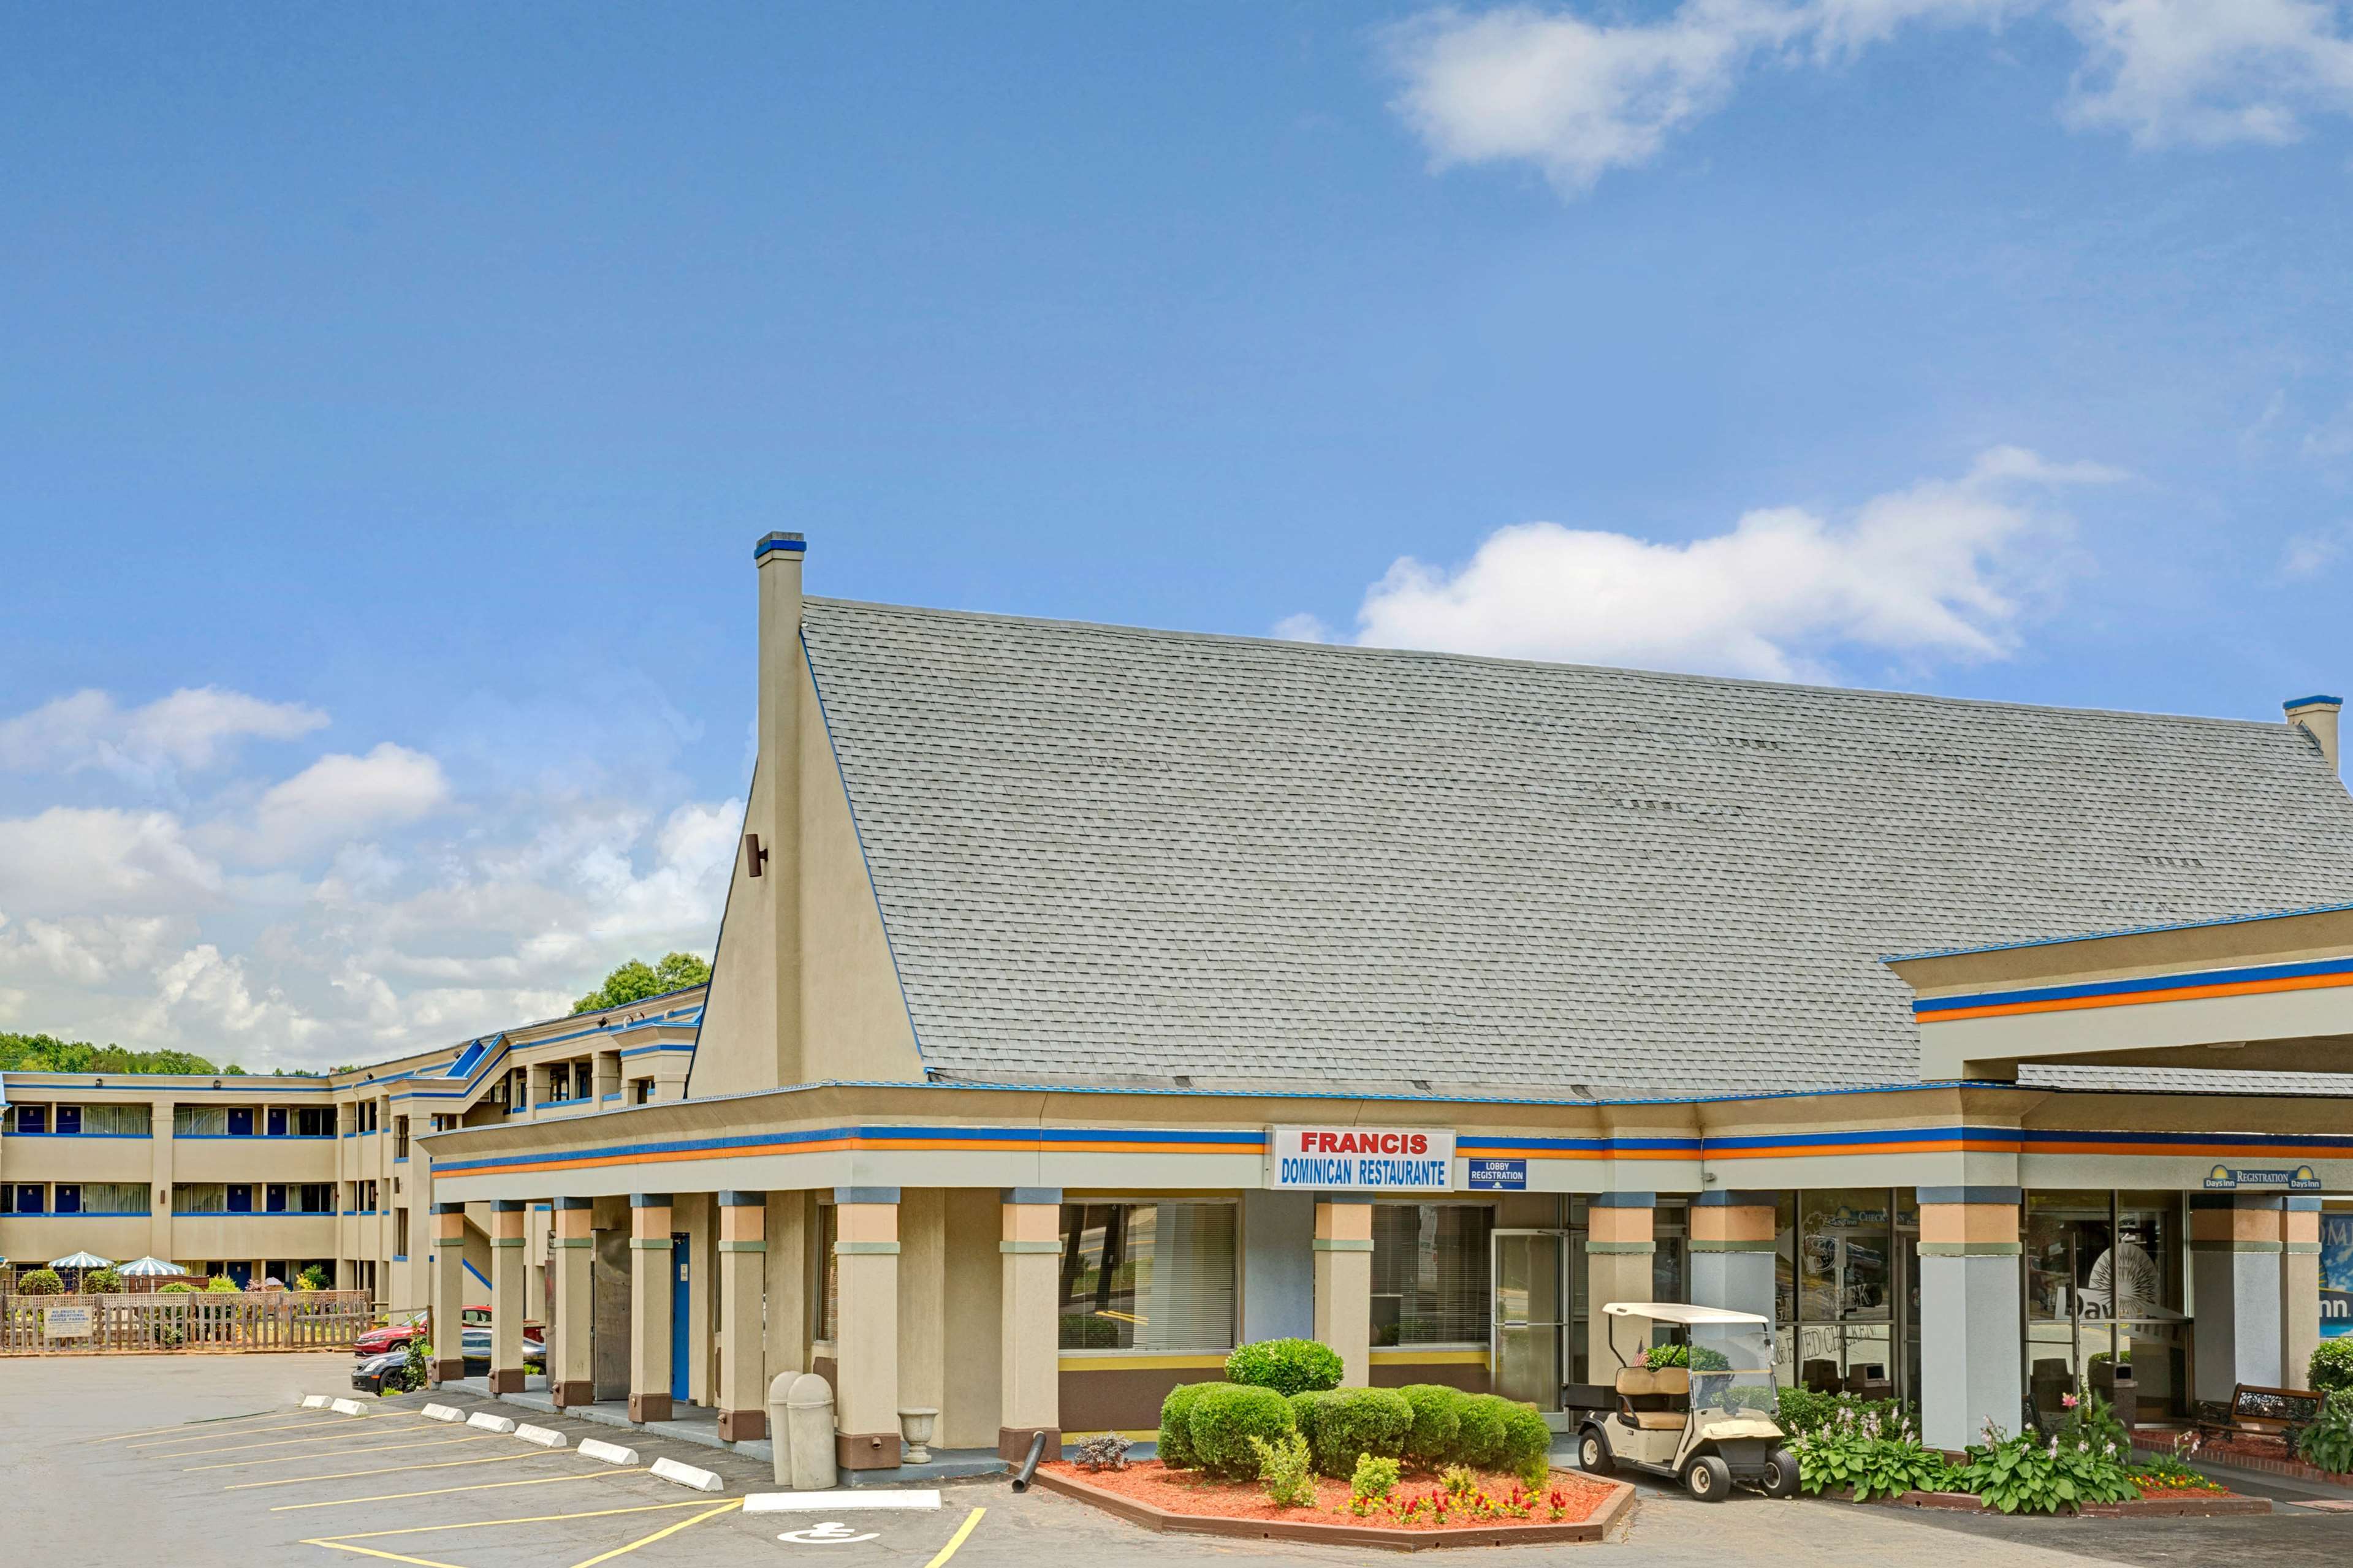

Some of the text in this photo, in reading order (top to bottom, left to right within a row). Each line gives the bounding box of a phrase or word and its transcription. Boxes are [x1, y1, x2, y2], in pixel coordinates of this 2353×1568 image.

[1301, 1132, 1427, 1154] FRANCIS
[1282, 1157, 1445, 1186] DOMINICAN RESTAURANTE
[1472, 1171, 1523, 1180] REGISTRATION
[2237, 1171, 2289, 1182] REGISTRATION
